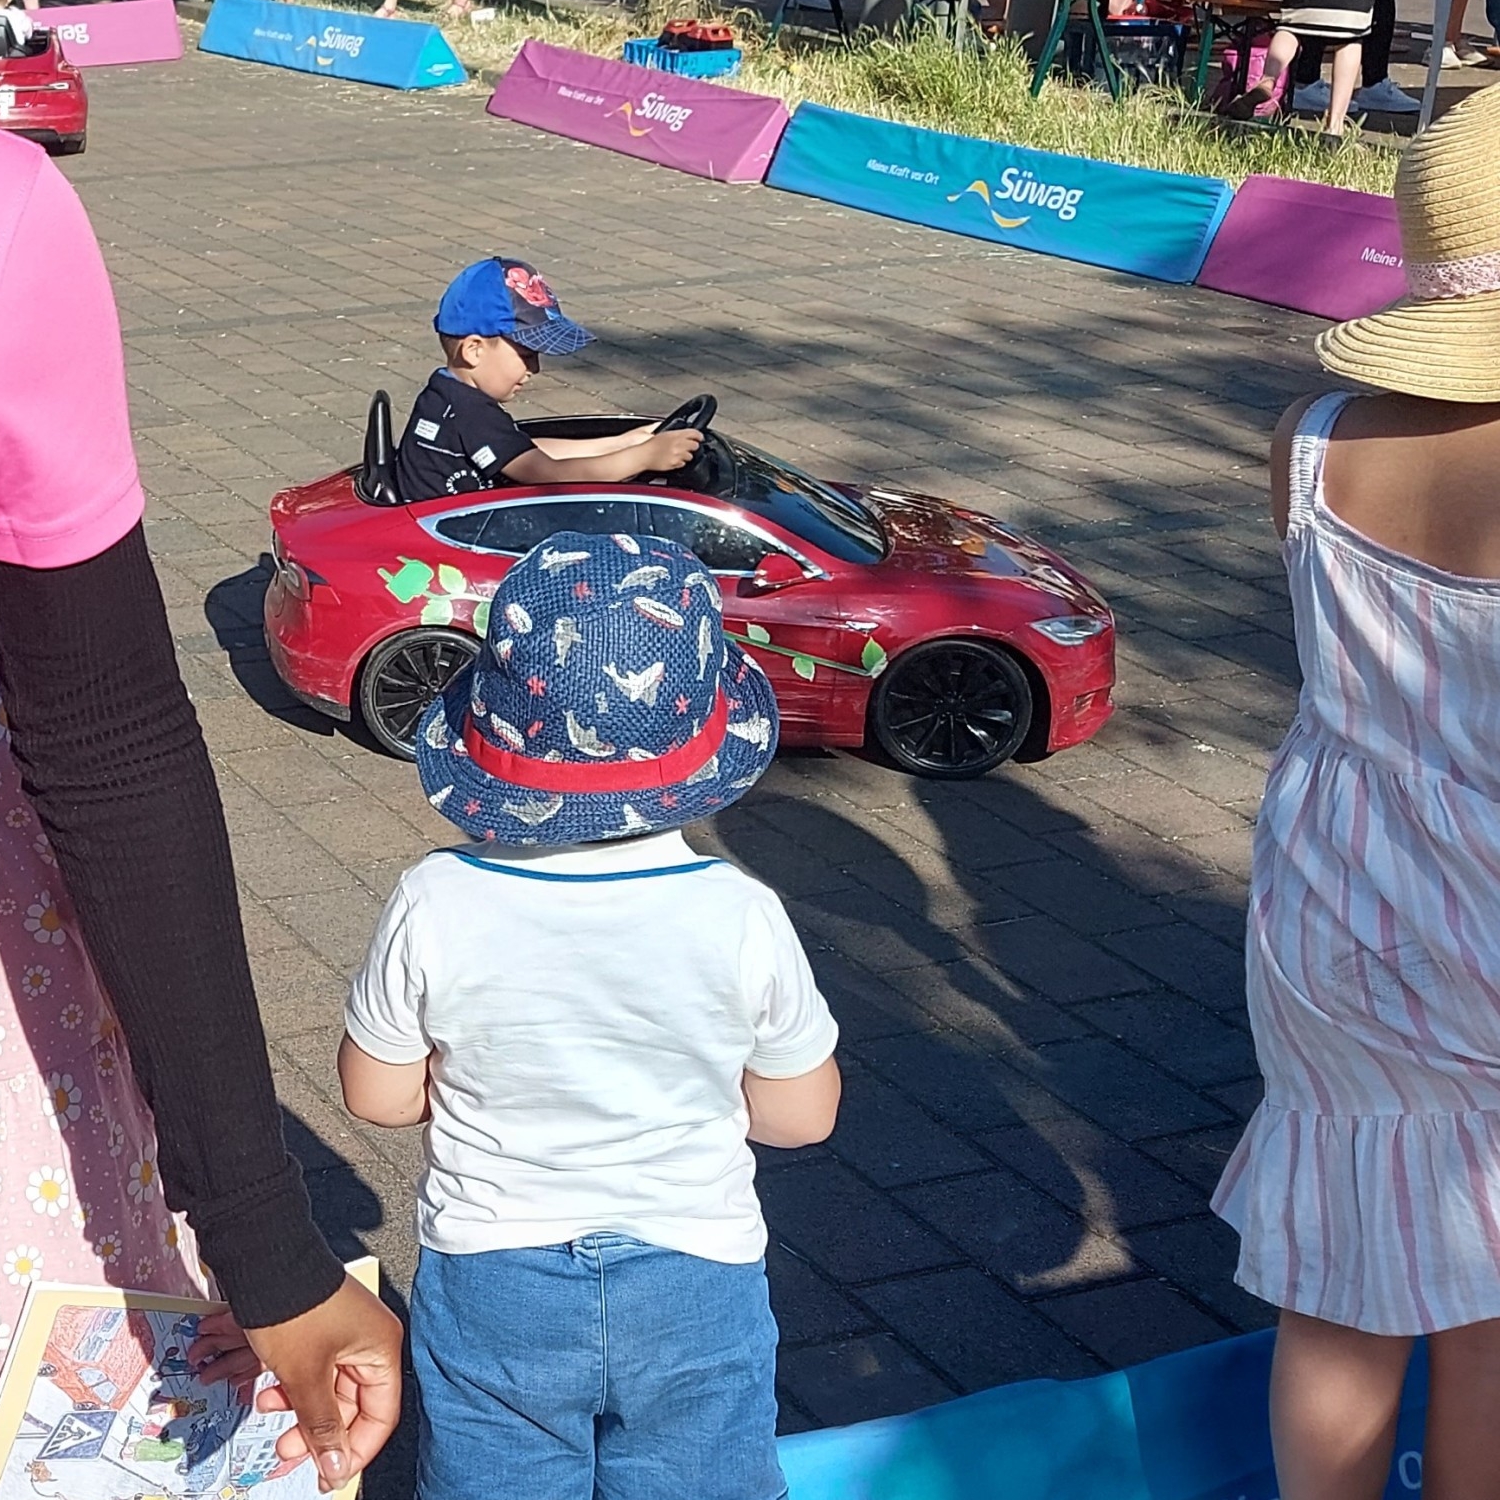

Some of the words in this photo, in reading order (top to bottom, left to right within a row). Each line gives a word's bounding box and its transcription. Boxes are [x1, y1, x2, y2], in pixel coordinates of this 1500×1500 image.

[319, 25, 365, 57] Süwag
[635, 92, 693, 132] Süwag
[924, 172, 940, 185] Ort
[995, 167, 1084, 221] Süwag
[1360, 246, 1398, 267] Meine
